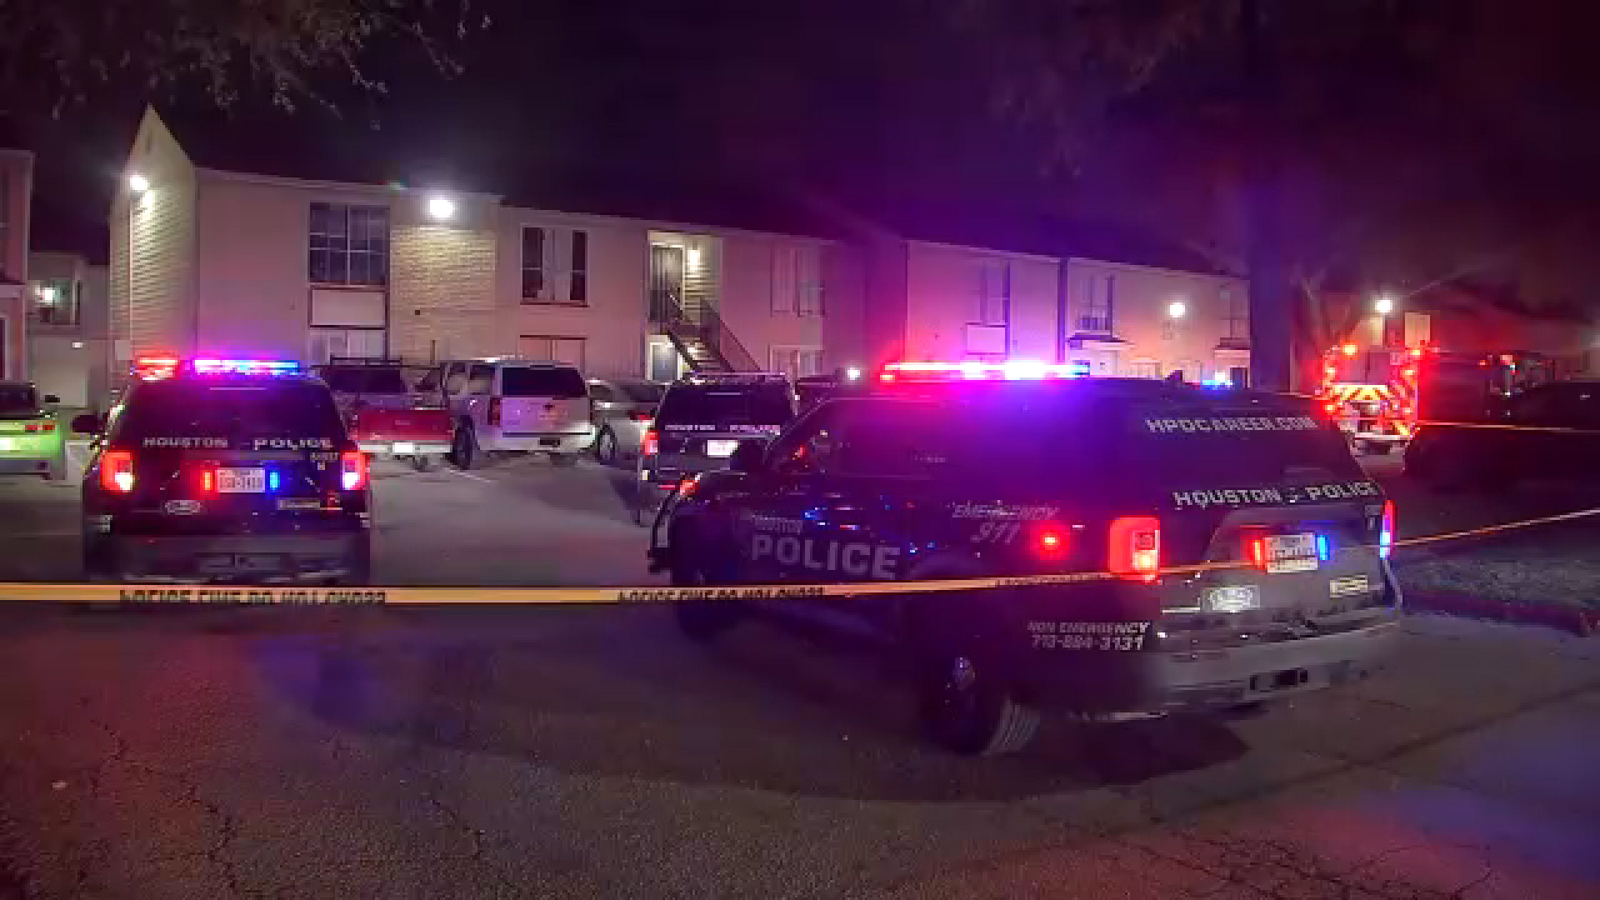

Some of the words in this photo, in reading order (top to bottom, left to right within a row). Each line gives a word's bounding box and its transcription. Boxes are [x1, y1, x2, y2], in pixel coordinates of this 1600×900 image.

[142, 436, 229, 449] HOUSTON
[253, 437, 334, 450] POLICE
[1172, 489, 1283, 508] HOUSTON
[751, 534, 901, 579] POLICE
